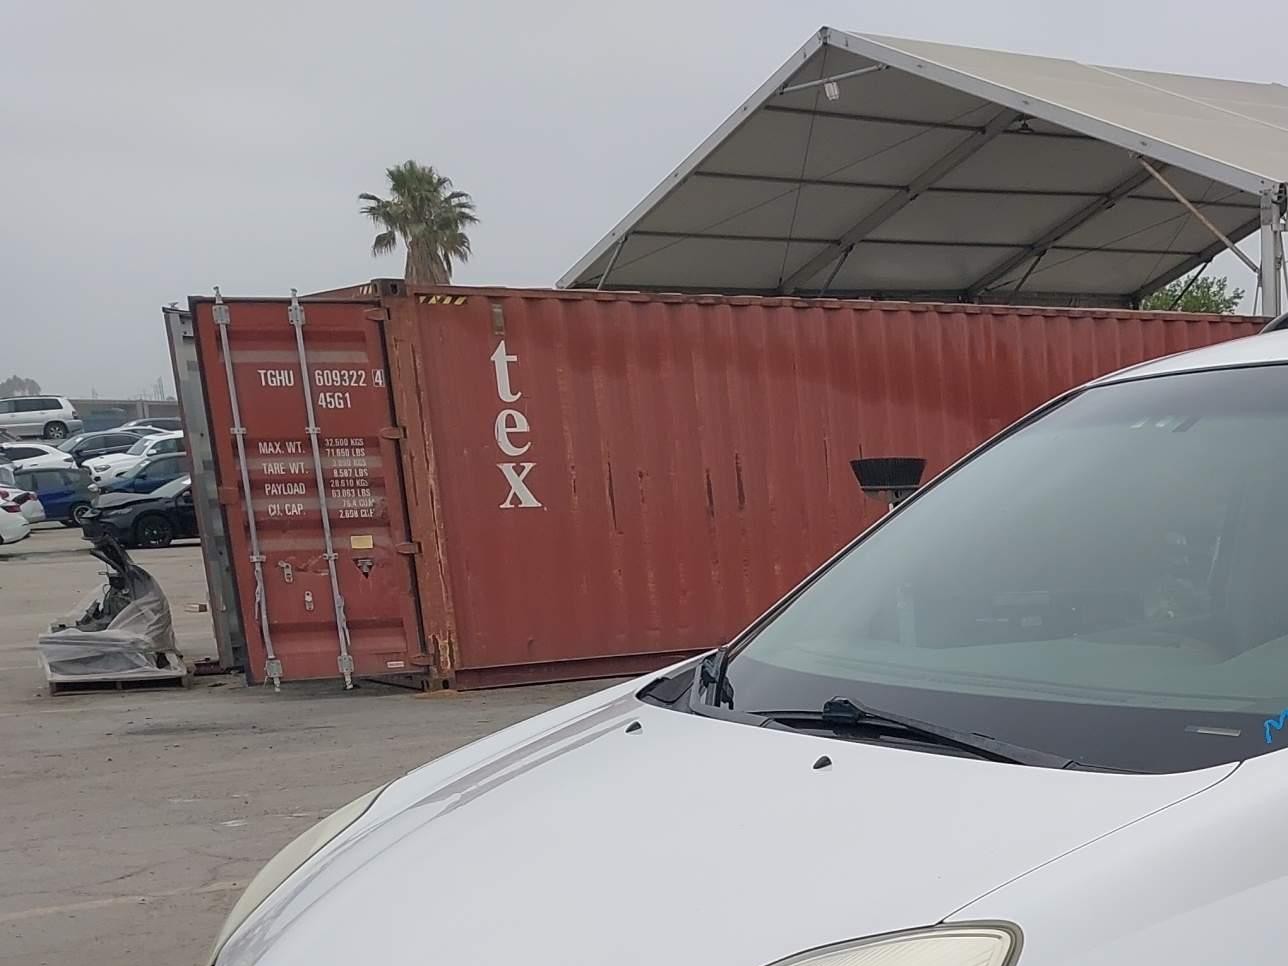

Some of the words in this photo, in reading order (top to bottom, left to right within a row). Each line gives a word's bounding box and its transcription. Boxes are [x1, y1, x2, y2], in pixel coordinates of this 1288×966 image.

[257, 369, 294, 387] TGHU
[315, 369, 367, 387] 609322
[373, 369, 384, 387] 4
[318, 392, 351, 409] 45G1
[491, 340, 542, 508] tex
[258, 441, 285, 455] MAX.
[286, 441, 306, 454] WT.
[351, 447, 366, 457] LBS
[262, 462, 286, 476] TARE
[289, 462, 309, 475] WT.
[354, 468, 369, 477] LBS
[264, 483, 306, 496] PAYLOAD
[357, 488, 371, 497] LBS
[284, 503, 306, 516] CAP.
